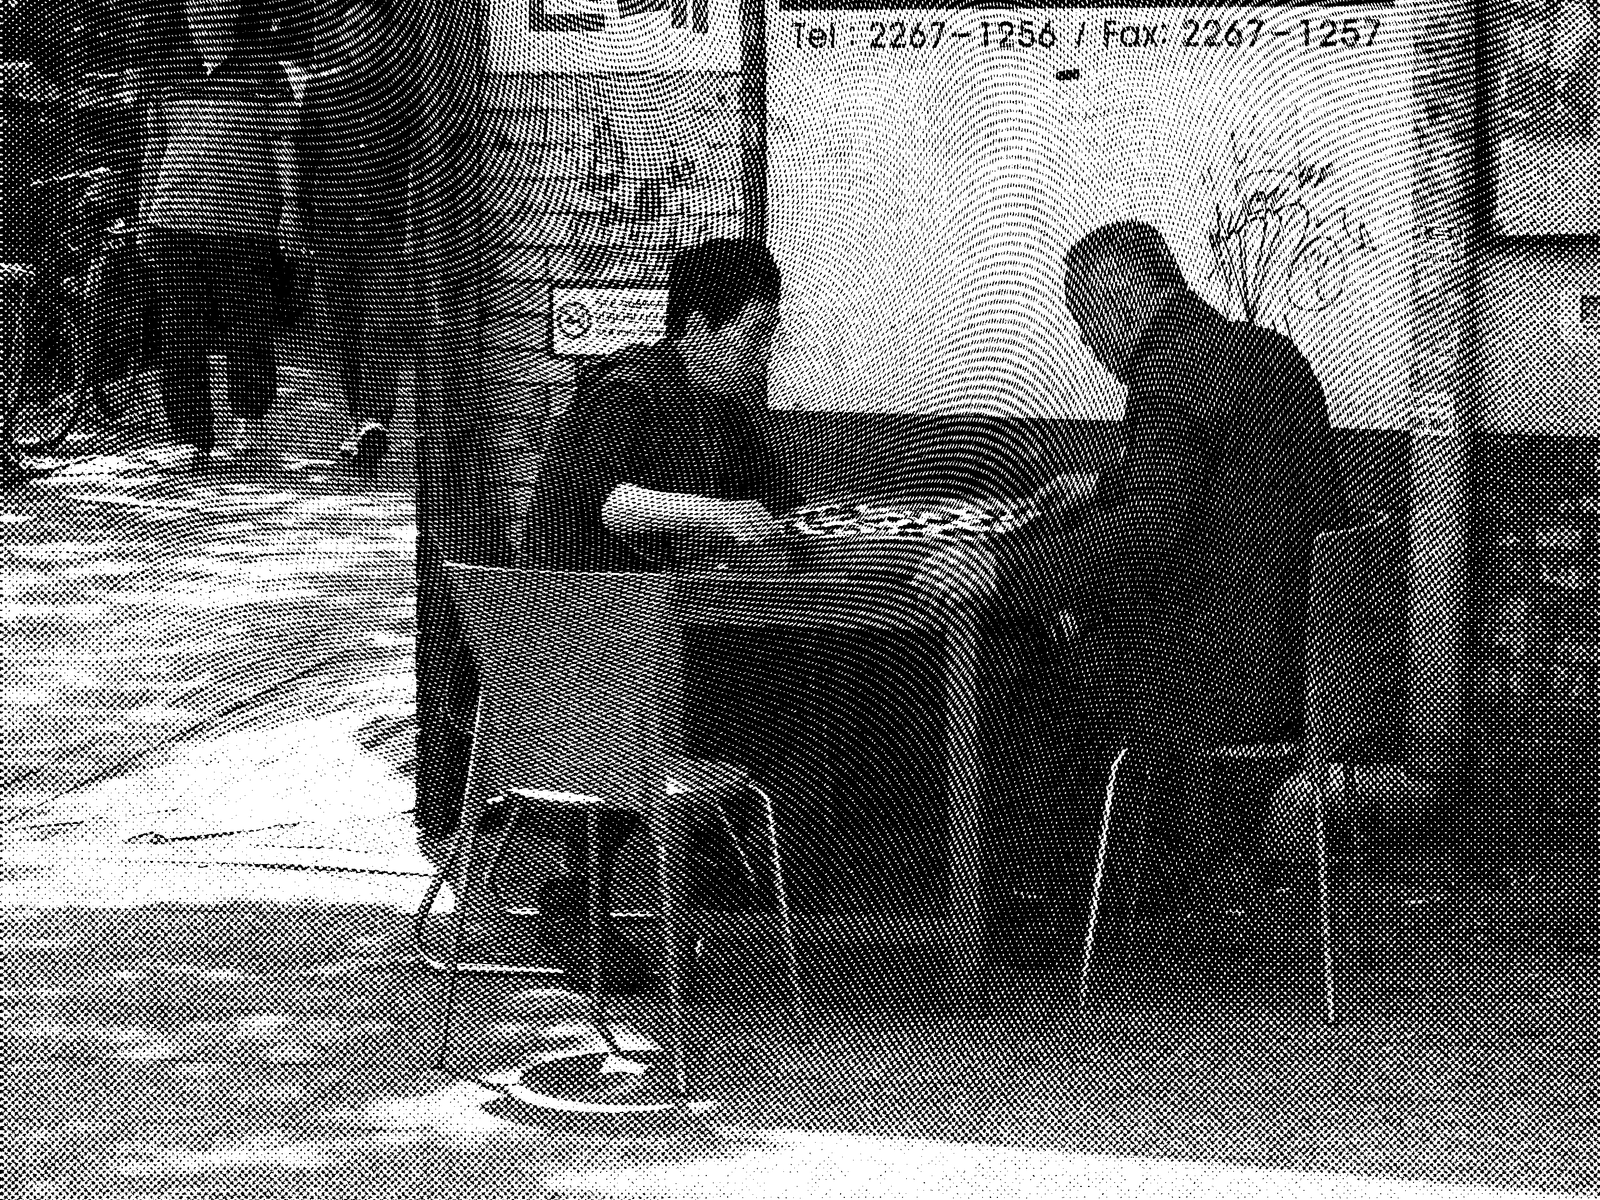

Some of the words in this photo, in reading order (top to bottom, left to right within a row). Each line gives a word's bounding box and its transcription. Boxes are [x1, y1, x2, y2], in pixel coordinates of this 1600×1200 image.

[792, 21, 836, 49] Tel
[868, 20, 1058, 49] 2267-1256
[1182, 17, 1381, 49] 2267-1257
